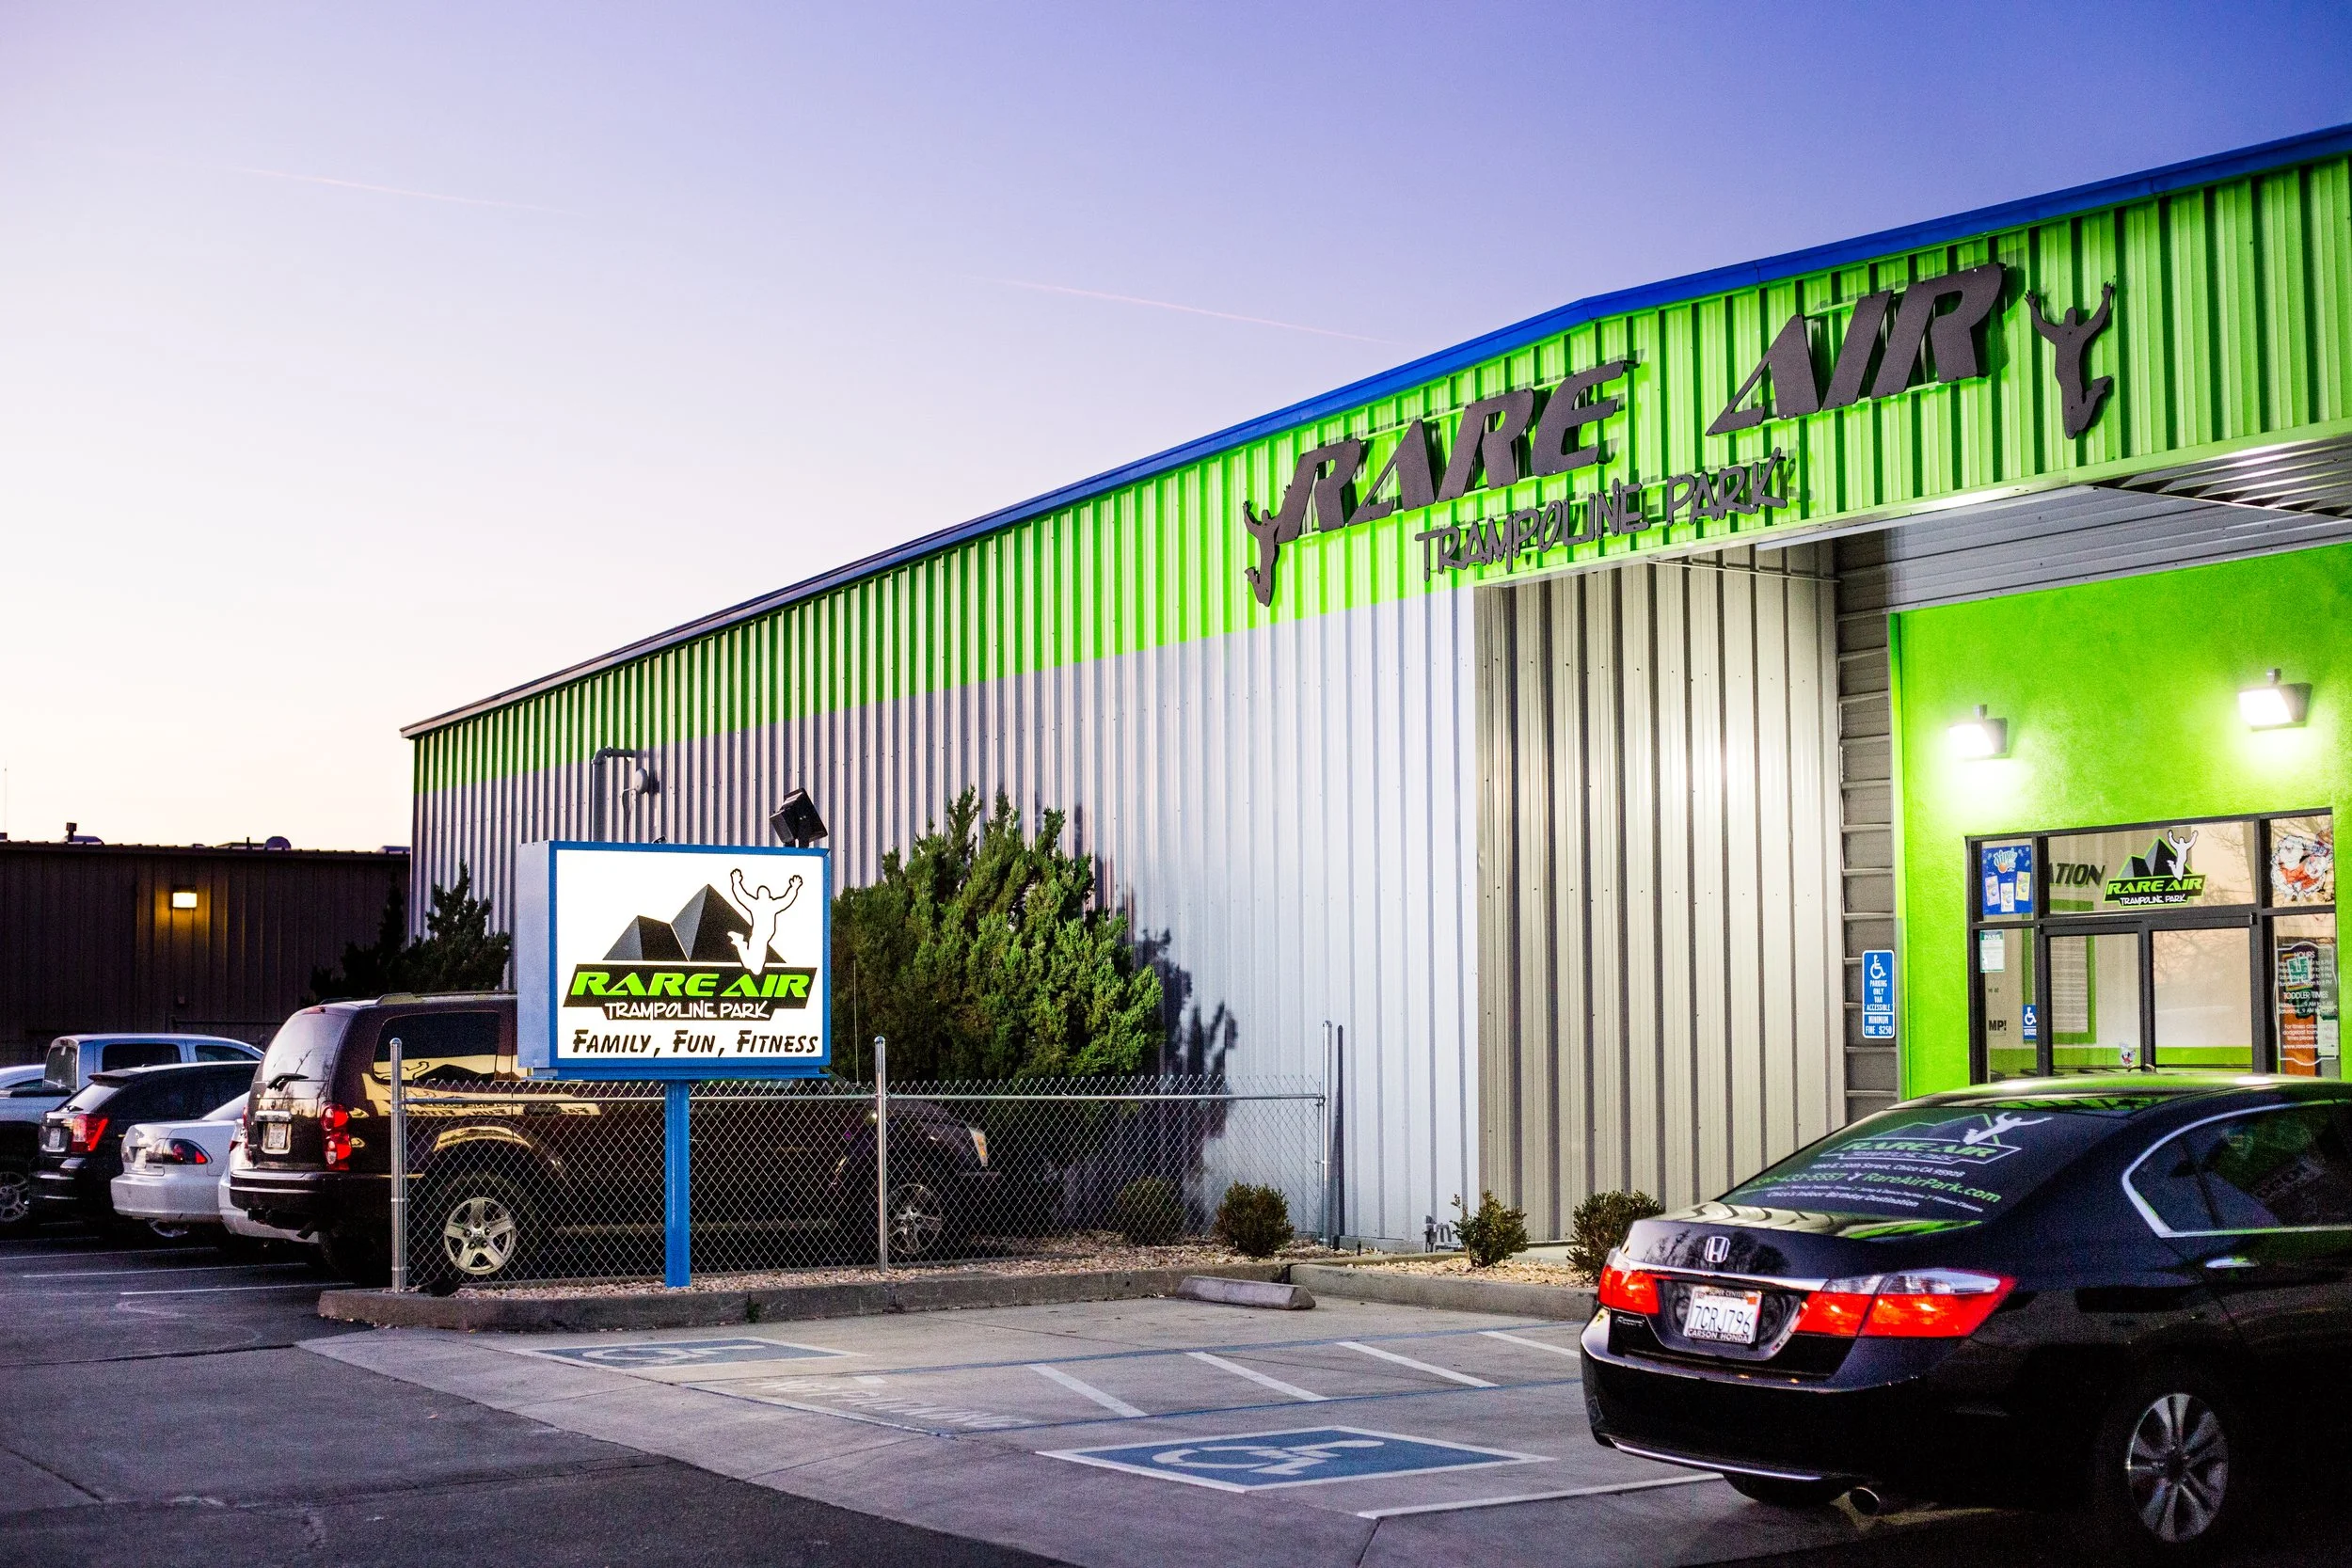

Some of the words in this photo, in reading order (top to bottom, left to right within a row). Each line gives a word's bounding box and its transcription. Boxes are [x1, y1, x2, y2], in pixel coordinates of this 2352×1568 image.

[1276, 358, 1628, 545] RARE
[1705, 261, 2006, 437] AIR
[1414, 477, 1651, 582] TRAMPOLINE
[1665, 446, 1788, 529] PARK
[2106, 879, 2165, 895] RARE
[2165, 878, 2203, 892] AIR
[2120, 895, 2165, 906] TRAMPOLINE
[2166, 894, 2186, 903] PARK
[569, 972, 721, 997] RARE
[720, 974, 810, 998] AIR
[1869, 979, 1887, 988] PARKING
[1874, 995, 1883, 1004] VAN
[2283, 991, 2310, 1000] TODDLER
[2312, 990, 2328, 999] TIMES
[604, 1000, 717, 1022] TRAMPOLINE
[720, 1000, 771, 1019] PARK
[1865, 1026, 1876, 1035] FINE
[1879, 1025, 1893, 1035] $250
[1988, 1020, 2007, 1032] MP!
[1841, 1141, 1936, 1152] RARE
[1927, 1144, 1998, 1158] AIR
[1862, 1172, 2002, 1203] RareAirPark.com
[1694, 1305, 1755, 1335] 7CRJ796
[1688, 1327, 1718, 1339] CARSON
[1720, 1332, 1752, 1344] HONDA
